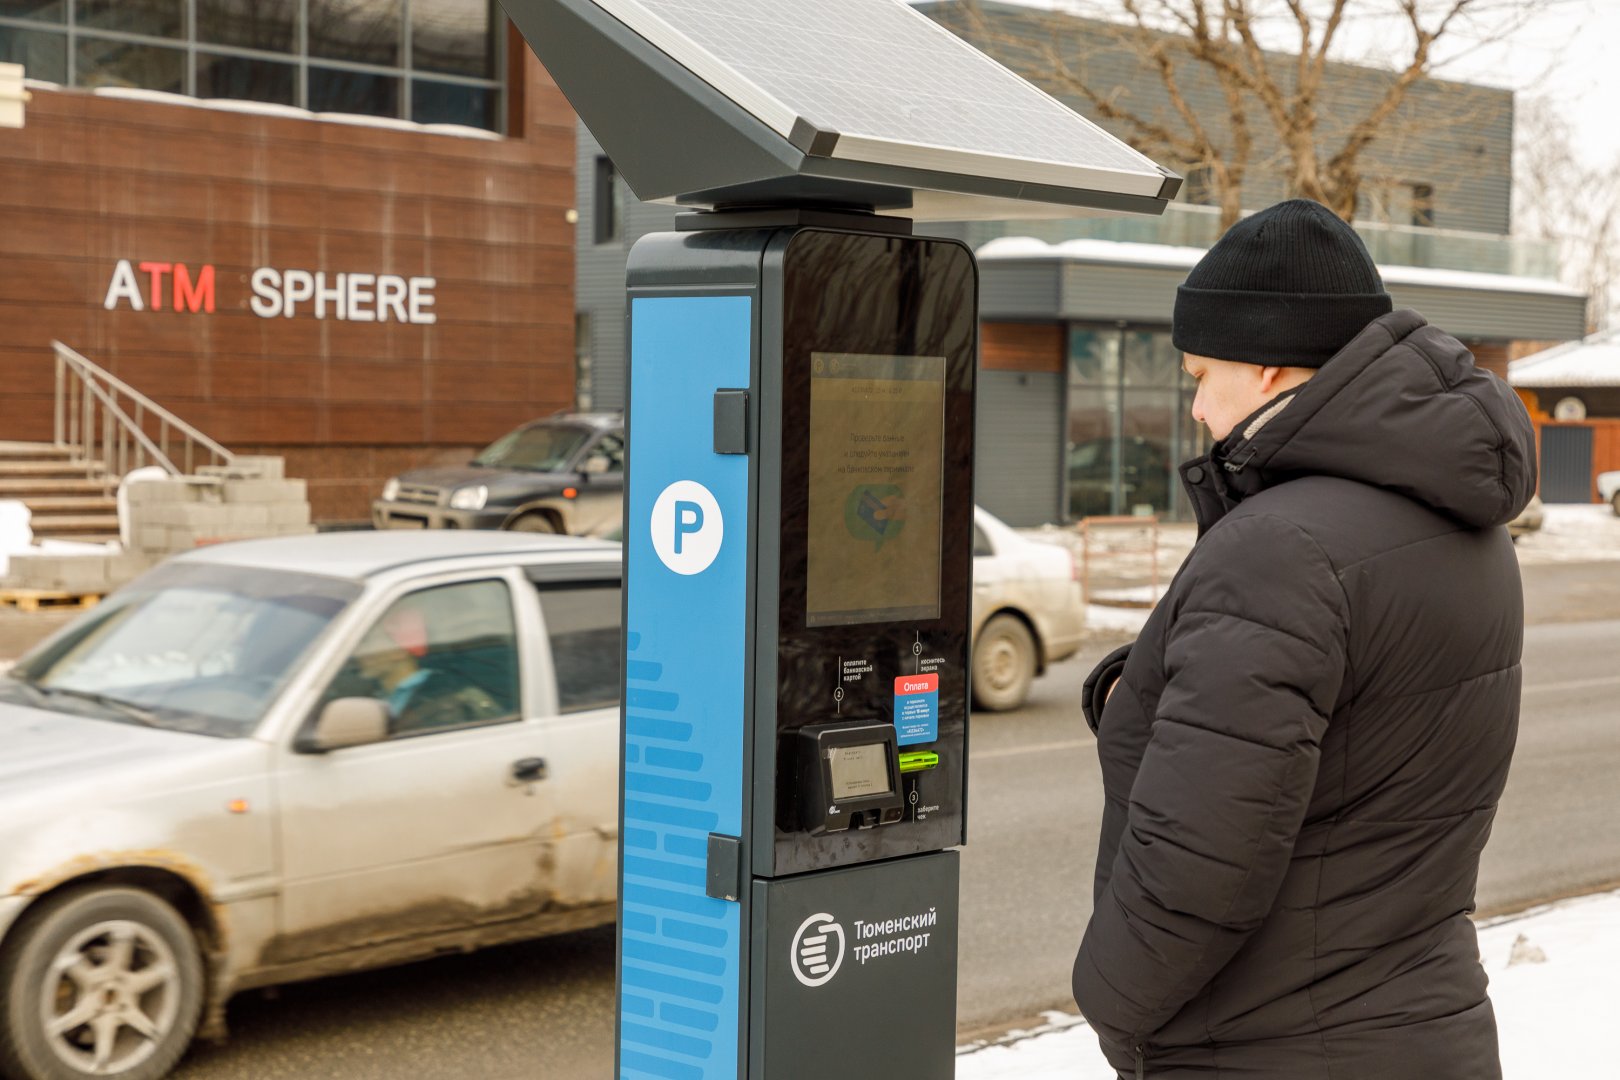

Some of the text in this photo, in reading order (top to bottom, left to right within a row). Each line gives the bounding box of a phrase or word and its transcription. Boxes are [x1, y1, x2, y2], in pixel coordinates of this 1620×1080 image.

[104, 259, 436, 324] ATM SPHERE
[674, 501, 704, 554] P
[920, 657, 946, 665] коснитесь
[843, 665, 873, 674] банковской
[843, 673, 862, 682] картой
[903, 682, 929, 692] Оплата
[917, 805, 940, 813] заберите
[854, 907, 936, 940] Тюменский
[854, 933, 930, 965] транспорт
